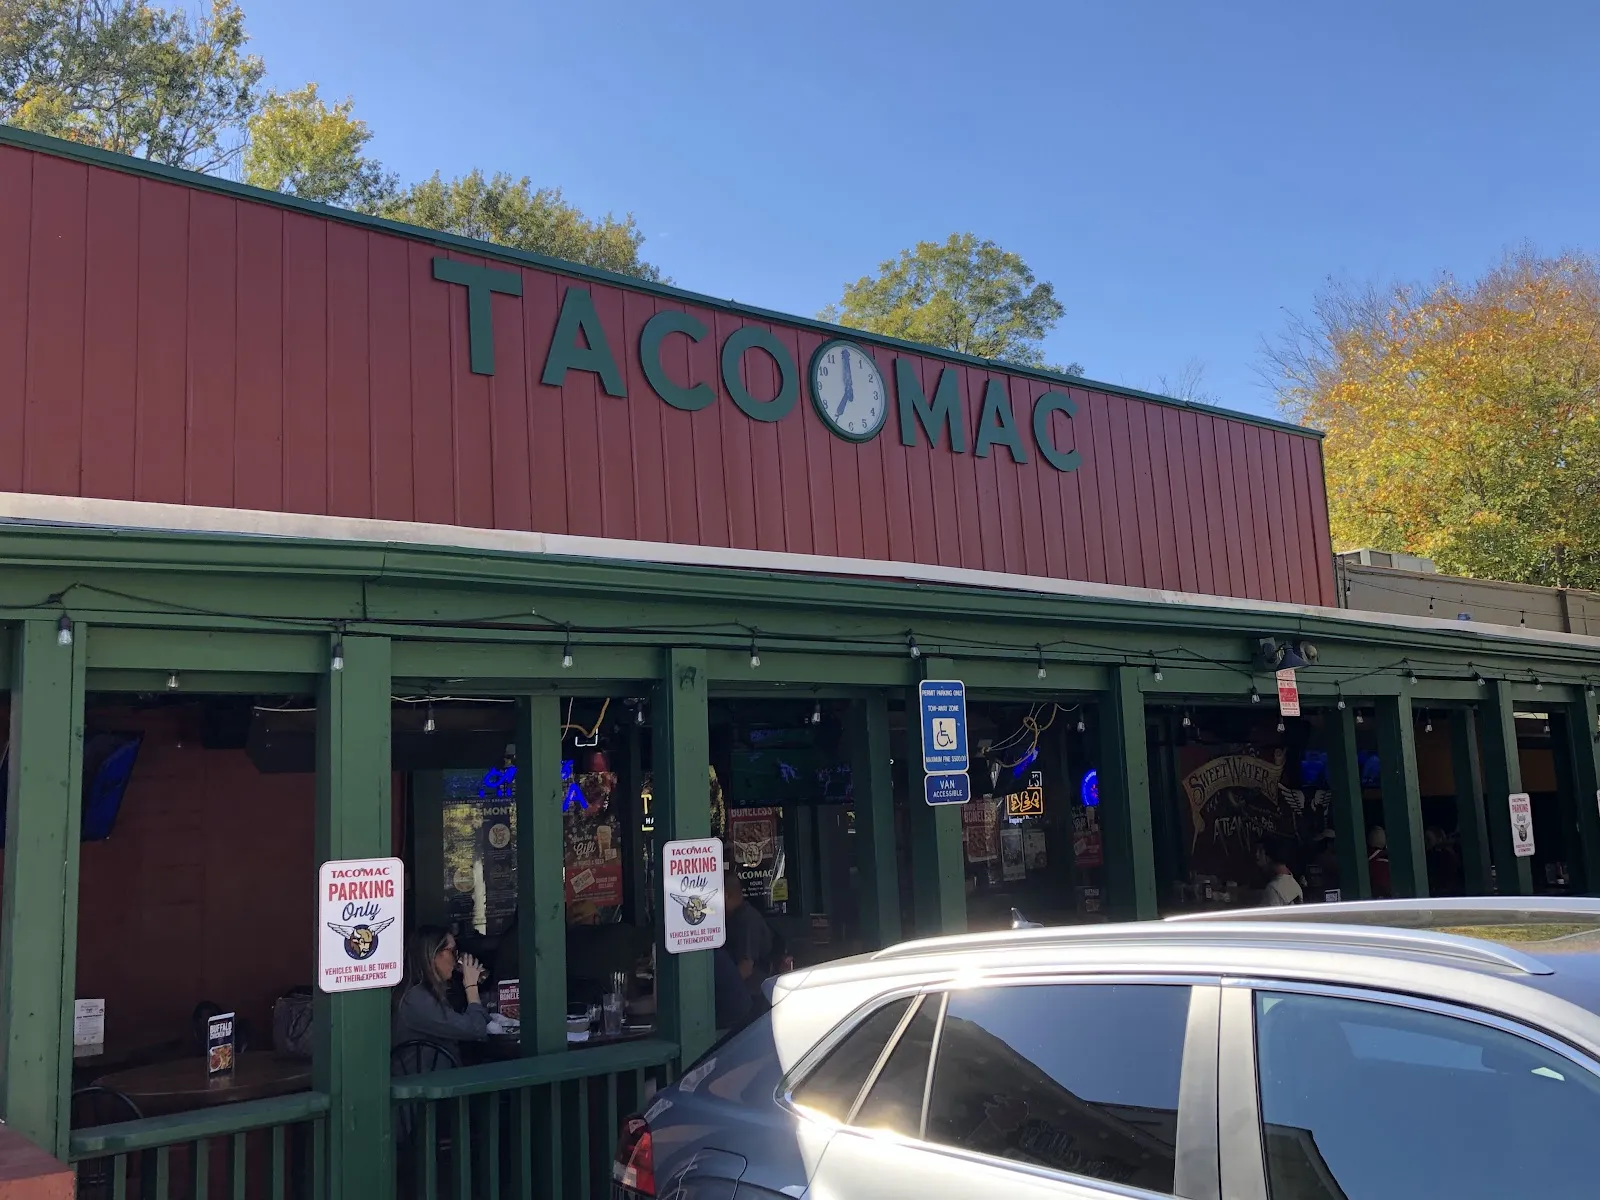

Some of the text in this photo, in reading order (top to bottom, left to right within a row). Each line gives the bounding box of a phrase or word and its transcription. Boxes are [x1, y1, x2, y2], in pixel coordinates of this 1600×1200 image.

[432, 256, 1081, 472] TACO MAC
[827, 354, 836, 364] 11
[819, 367, 828, 376] 10
[868, 373, 873, 383] 2
[817, 381, 823, 390] 9
[873, 390, 879, 401] 3
[822, 400, 829, 409] 8
[870, 407, 876, 417] 4
[848, 421, 854, 432] 6
[861, 418, 867, 429] 5
[940, 780, 955, 789] VAN
[933, 789, 963, 798] ACCESSIBLE
[670, 856, 717, 876] PARKING
[680, 876, 708, 892] Only
[328, 879, 395, 902] PARKING
[342, 901, 381, 921] Only
[669, 930, 690, 939] VEHICLES
[690, 928, 700, 937] WILL
[707, 926, 721, 934] TOWED
[696, 934, 714, 943] EXPENSE
[325, 961, 397, 976] VEHICLES WILL BE TOWED
[335, 971, 387, 984] AT THEIR EXPENSE
